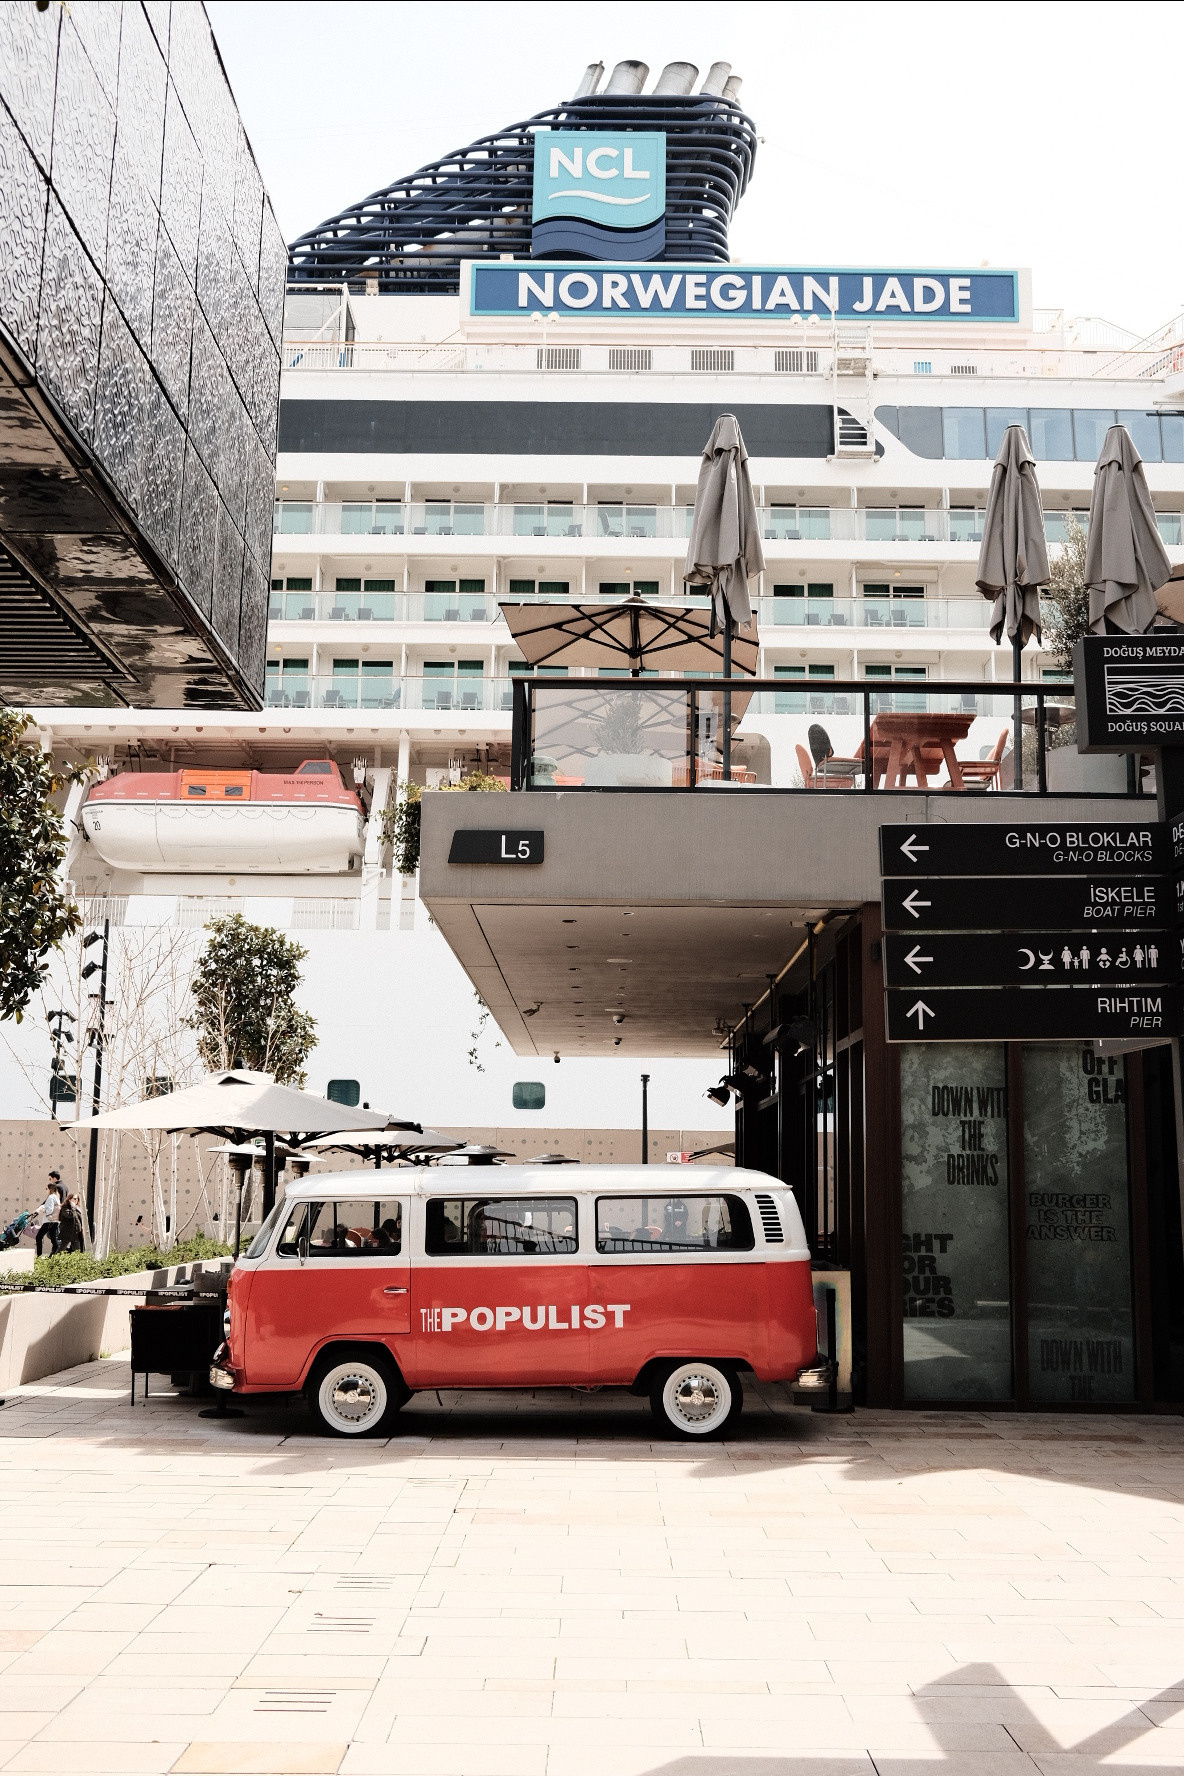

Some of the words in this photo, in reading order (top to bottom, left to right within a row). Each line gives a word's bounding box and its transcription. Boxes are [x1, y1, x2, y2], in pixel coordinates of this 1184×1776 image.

[549, 147, 651, 180] NCL
[517, 271, 839, 313] NORWEGIAN
[852, 276, 972, 314] JADE
[1103, 645, 1144, 660] DOĞUŞ
[1107, 719, 1148, 735] DOĞUŞ
[500, 834, 530, 859] L5
[1005, 832, 1061, 848] G-N-O
[1065, 831, 1153, 848] BLOKLAR
[1053, 850, 1094, 863] G-N-O
[1096, 850, 1153, 862] BLOCKS
[1089, 884, 1156, 902] İSKELE
[1083, 905, 1122, 918] BOAT
[1123, 905, 1156, 917] PIER
[1097, 997, 1162, 1013] RIHTIM
[1129, 1015, 1162, 1028] PIER
[932, 1085, 974, 1118] DOWN
[959, 1120, 985, 1151] THE
[946, 1153, 999, 1186] DRINKS
[1029, 1193, 1112, 1210] BURGER
[1036, 1208, 1059, 1224] IS
[1061, 1209, 1104, 1225] THE
[1026, 1225, 1117, 1242] ANSWER
[419, 1308, 442, 1333] THE
[441, 1304, 631, 1333] POPULIST
[1040, 1339, 1083, 1373] DOWN
[1085, 1340, 1123, 1374] WITH
